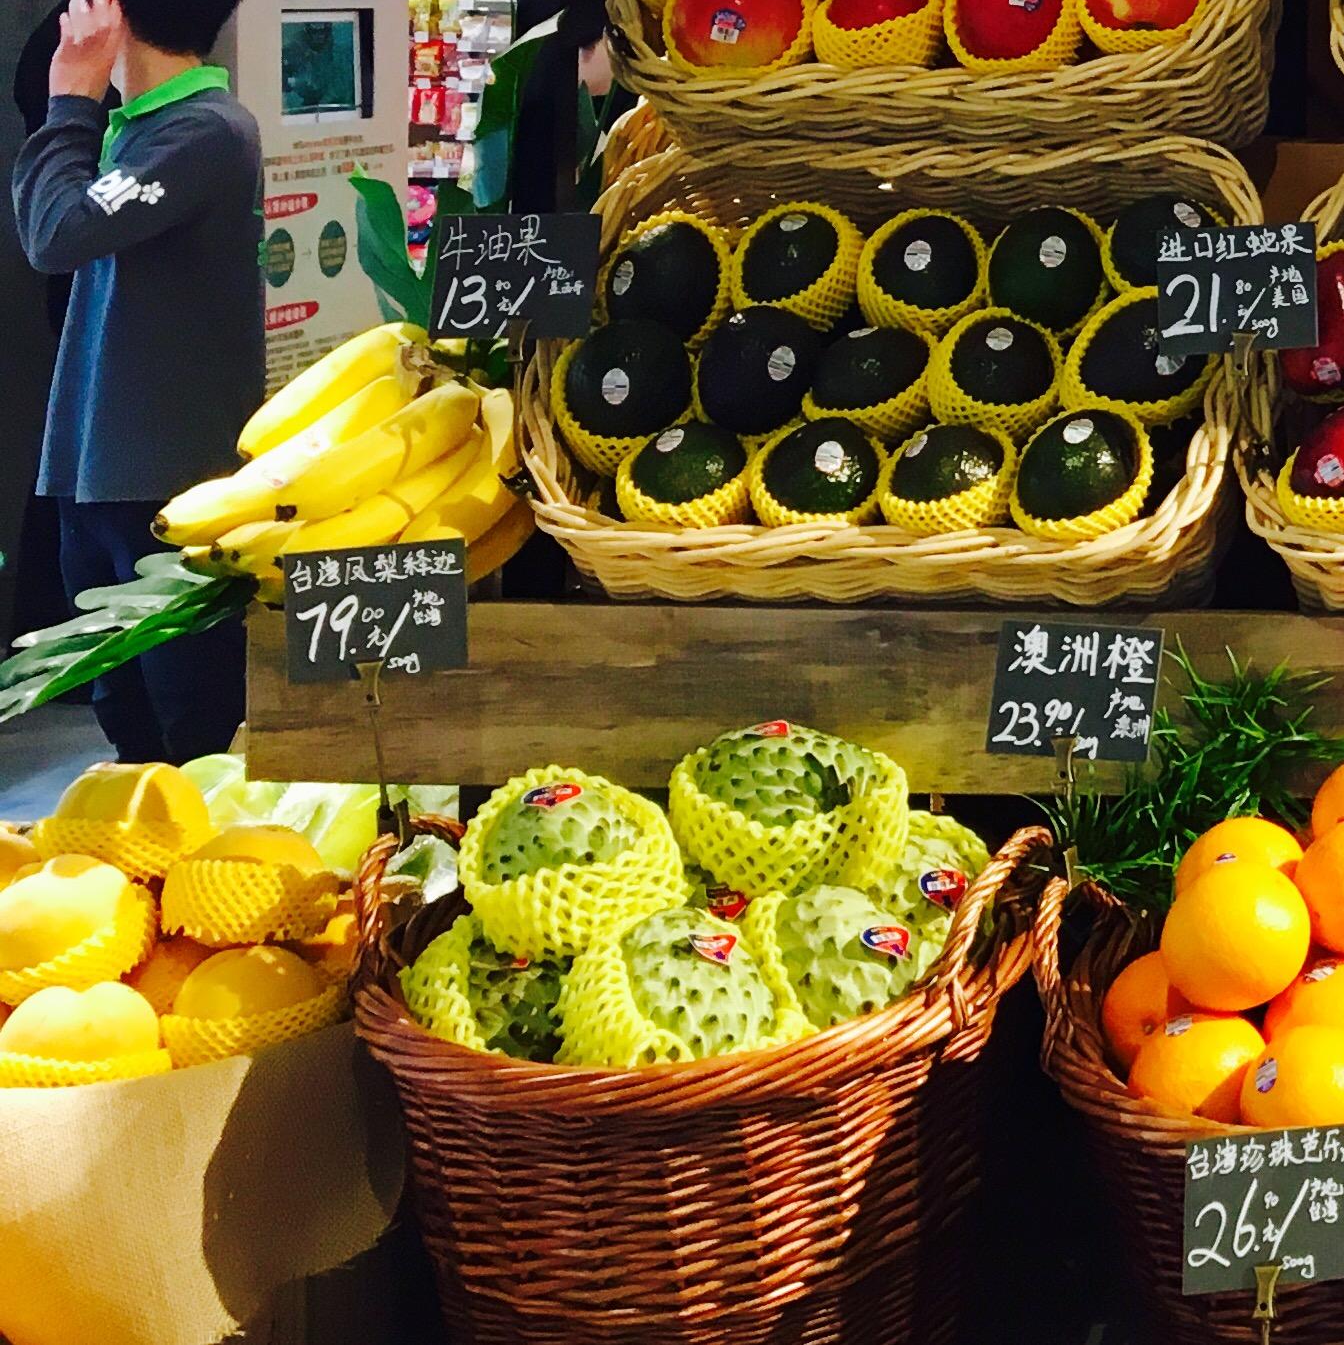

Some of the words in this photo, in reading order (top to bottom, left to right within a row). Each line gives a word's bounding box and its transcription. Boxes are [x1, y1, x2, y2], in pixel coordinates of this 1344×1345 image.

[440, 214, 561, 270] 牛油果
[1157, 224, 1312, 262] 进口红蛇果
[1272, 284, 1309, 308] 美国
[1008, 624, 1155, 683] 澳洲橙
